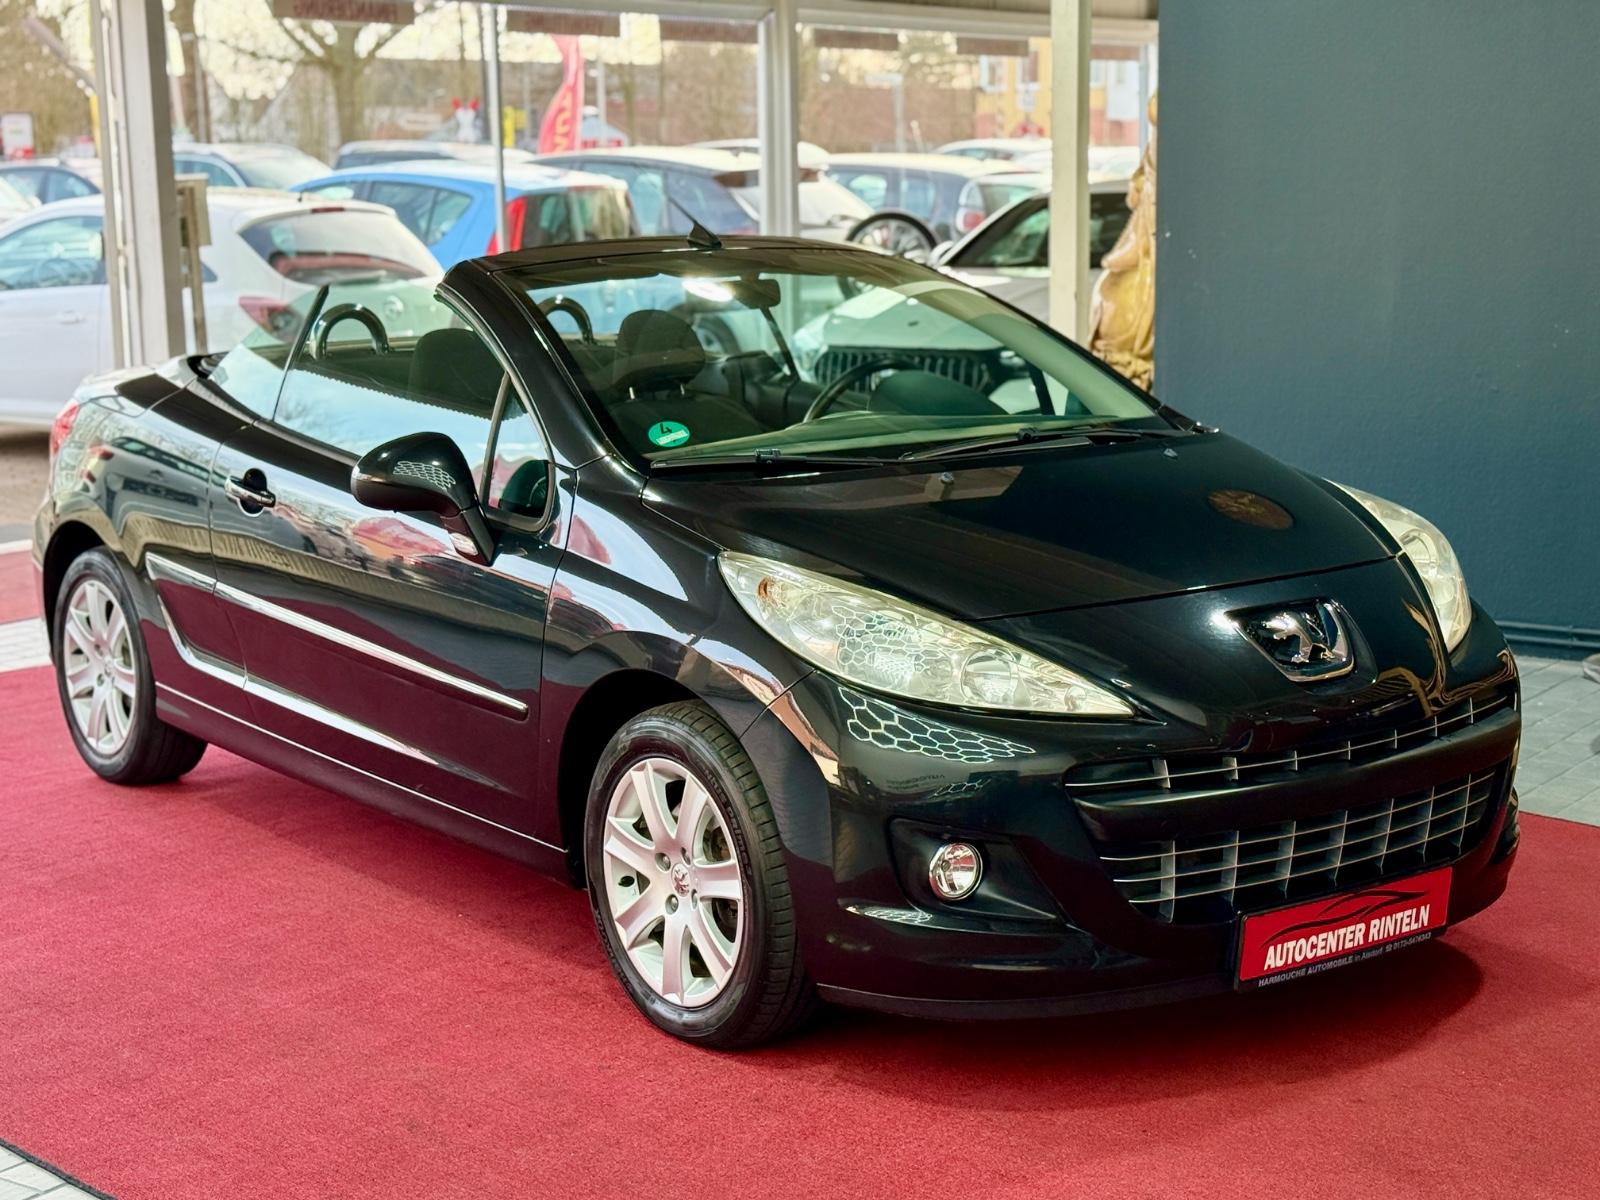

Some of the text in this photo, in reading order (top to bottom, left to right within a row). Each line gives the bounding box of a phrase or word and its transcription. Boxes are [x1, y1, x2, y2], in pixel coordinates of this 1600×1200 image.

[659, 422, 672, 434] 4
[1263, 904, 1431, 971] AUTOCENTER RINTELN
[1258, 968, 1306, 988] HARMOUCHE
[1307, 956, 1353, 975] AUTOMOBILE
